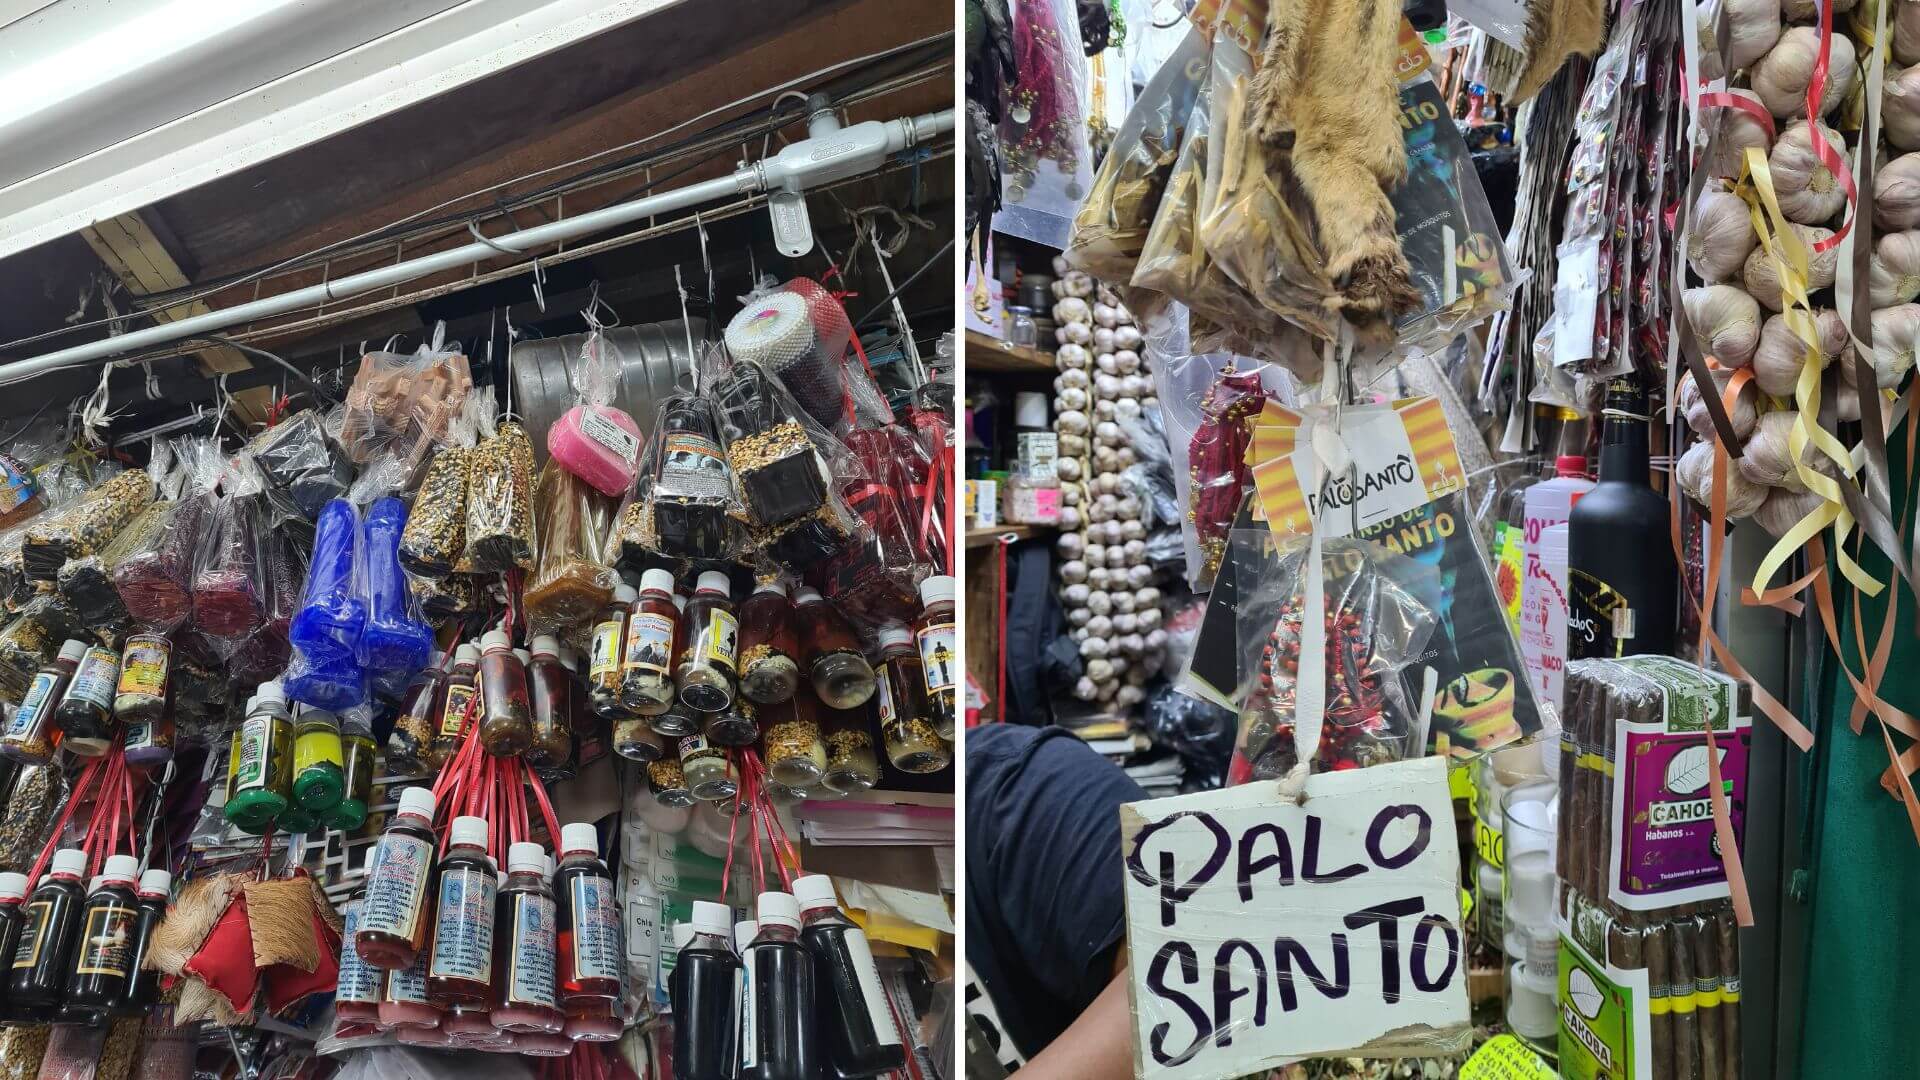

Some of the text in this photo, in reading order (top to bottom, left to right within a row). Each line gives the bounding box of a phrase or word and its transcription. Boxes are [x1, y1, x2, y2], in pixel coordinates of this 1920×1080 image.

[1414, 649, 1439, 665] QUITOS
[1125, 804, 1432, 927] PALO
[1645, 829, 1684, 841] Habanos
[1146, 896, 1460, 1067] SANTO
